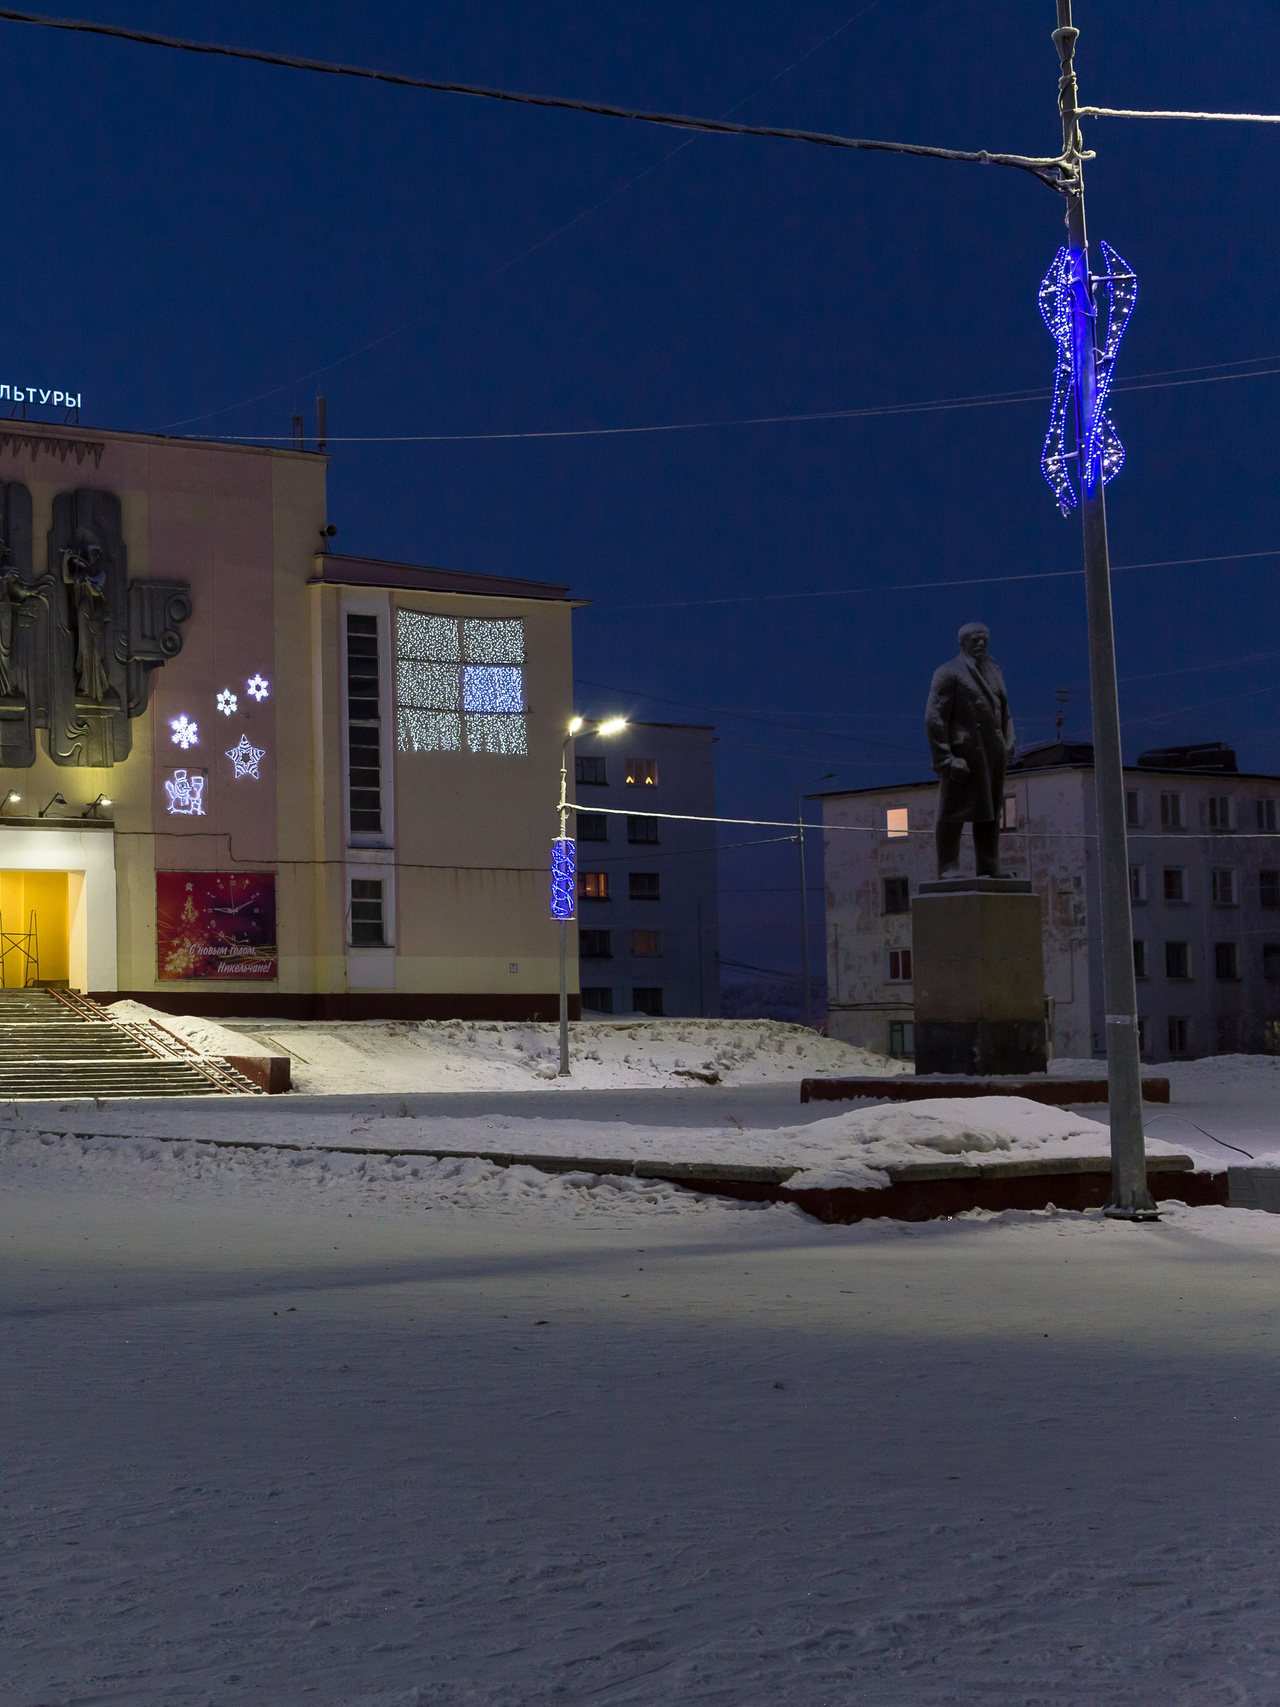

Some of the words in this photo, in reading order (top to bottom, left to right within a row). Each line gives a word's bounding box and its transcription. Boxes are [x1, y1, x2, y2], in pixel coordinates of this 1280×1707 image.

[189, 944, 197, 955] С
[198, 946, 227, 956] новым
[217, 962, 272, 973] Никельчане!
